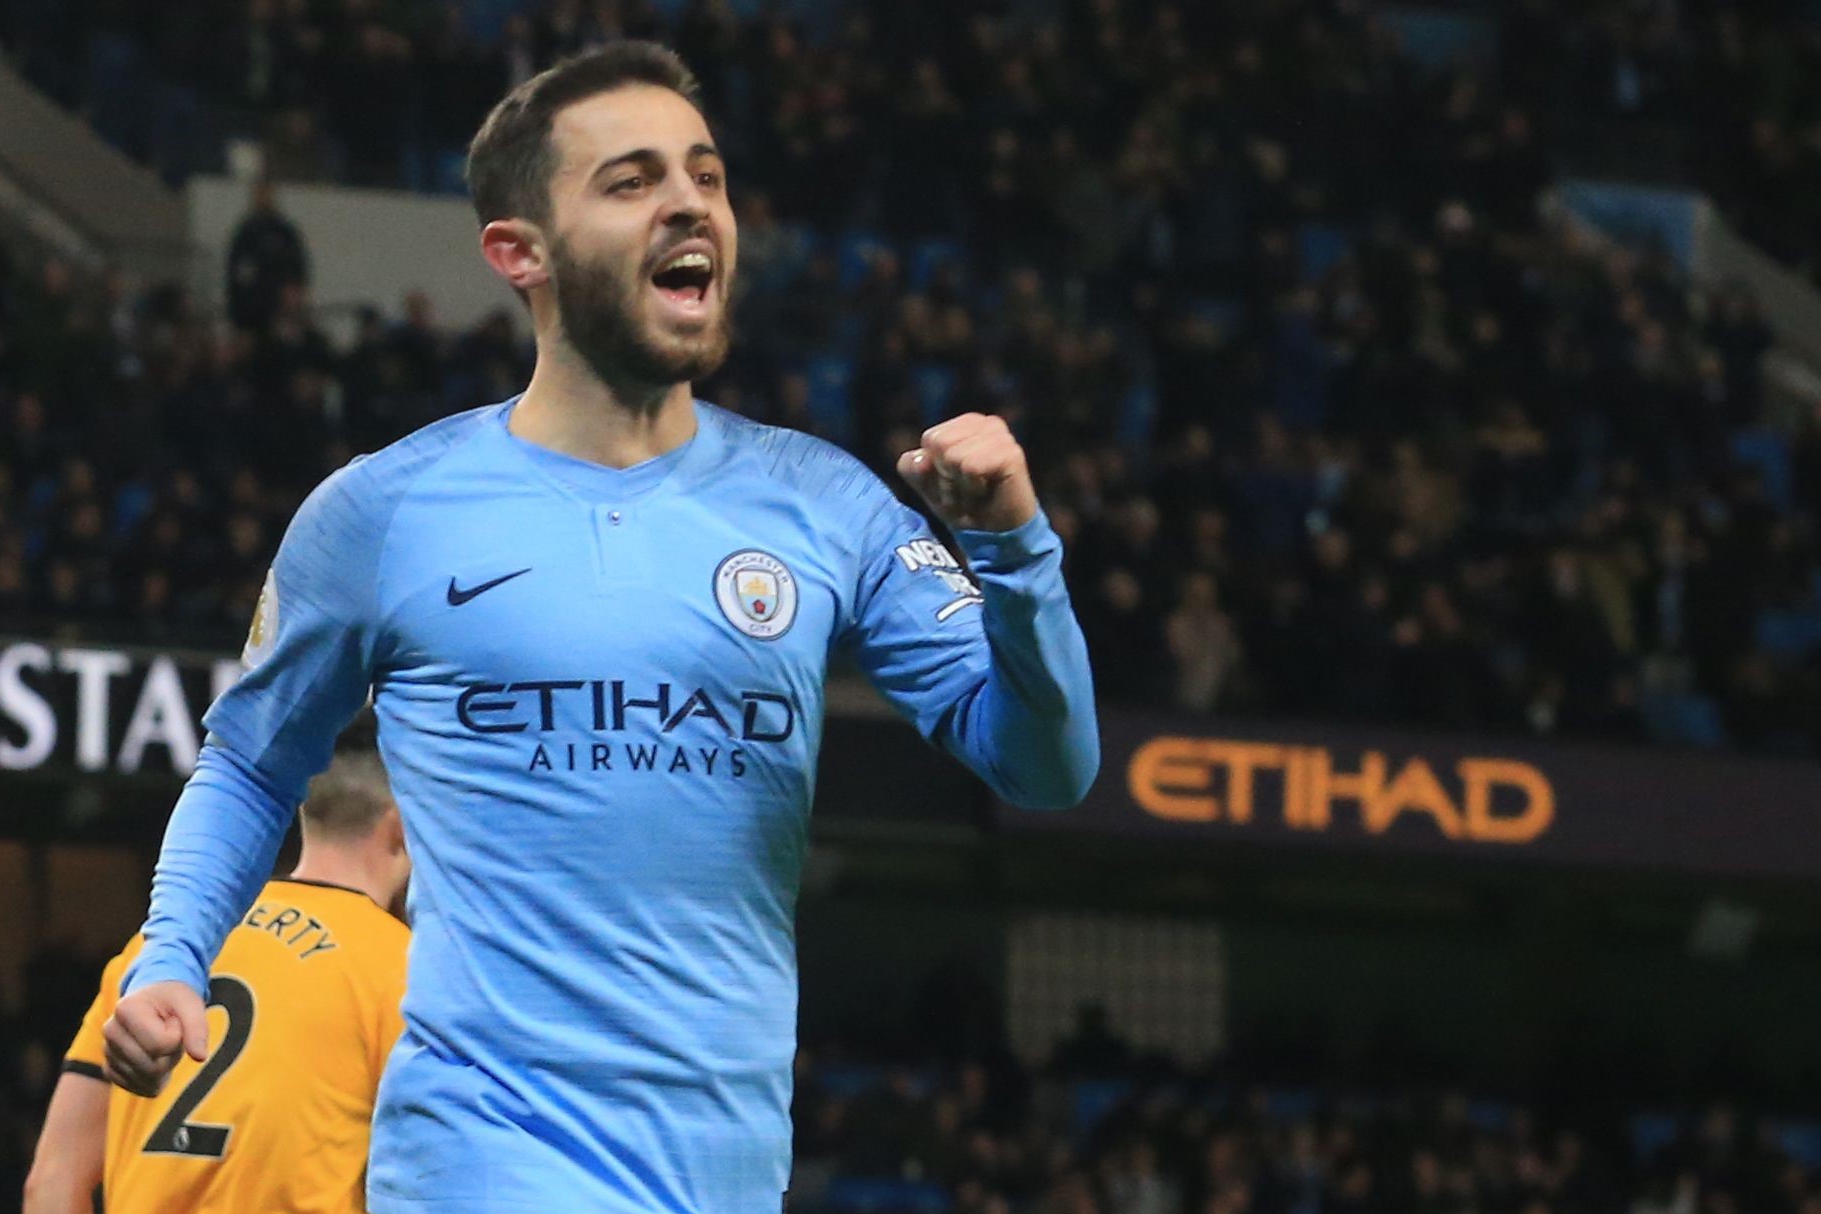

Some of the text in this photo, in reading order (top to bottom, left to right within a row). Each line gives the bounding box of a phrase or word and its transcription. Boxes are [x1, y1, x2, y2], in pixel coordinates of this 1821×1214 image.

[455, 680, 796, 743] ETIHAD
[529, 743, 747, 779] AIRWAYS
[1127, 735, 1556, 844] ETIHAD
[246, 907, 337, 960] ERTY
[141, 975, 256, 1159] 2
